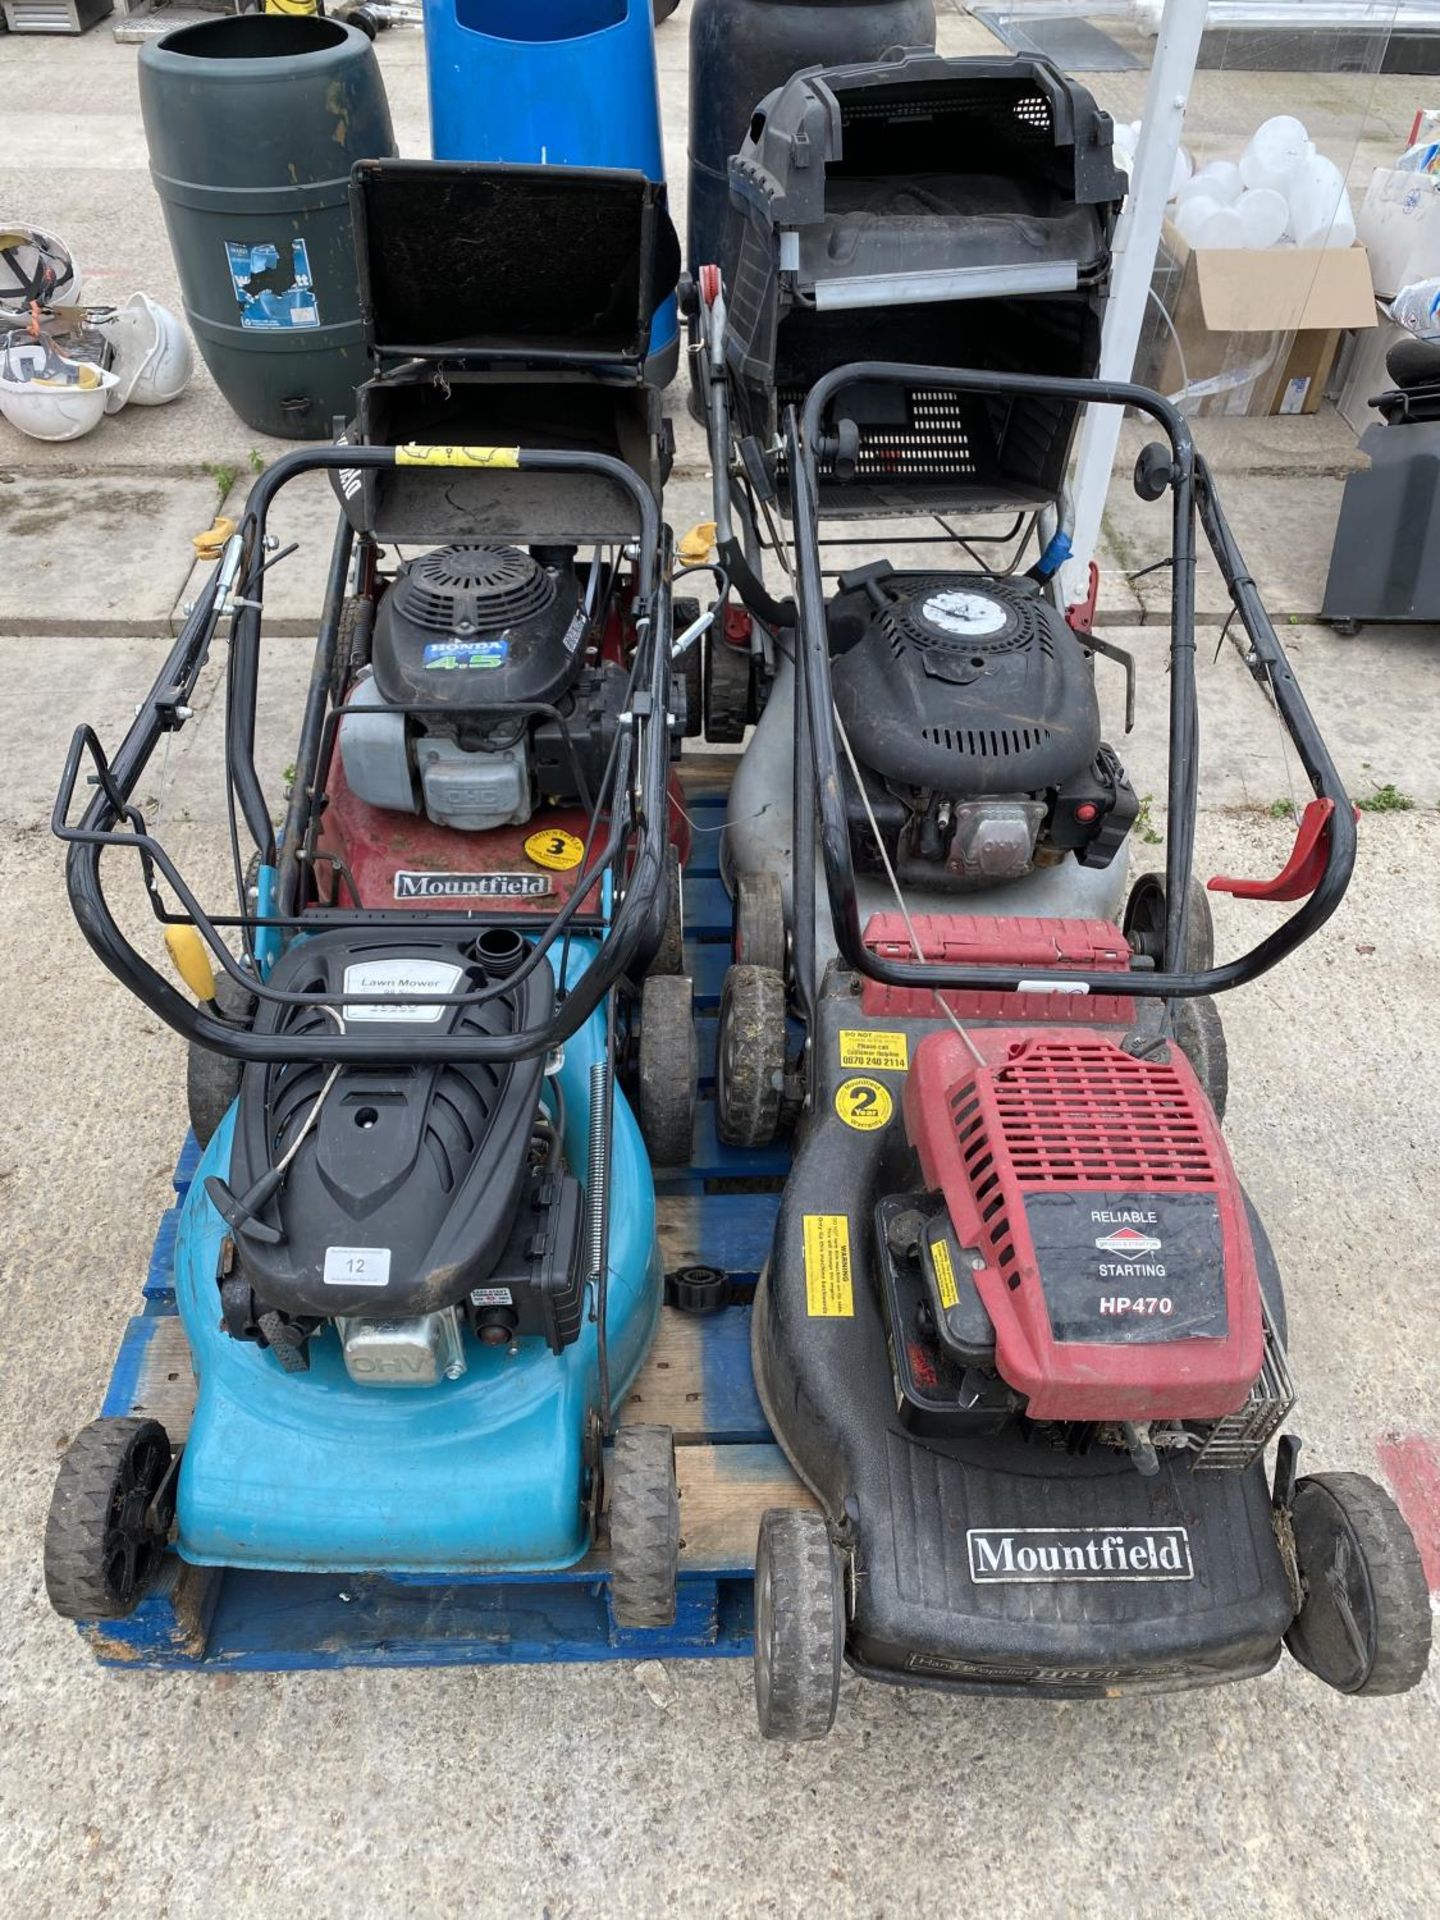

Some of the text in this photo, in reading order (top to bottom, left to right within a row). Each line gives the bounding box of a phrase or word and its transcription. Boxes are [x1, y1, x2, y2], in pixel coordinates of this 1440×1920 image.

[430, 642, 503, 651] HONDA
[424, 654, 503, 669] 4.5
[546, 837, 566, 855] 3
[401, 876, 546, 896] Mountfield
[361, 978, 441, 988] Lawn Mower
[843, 1055, 905, 1068] 0870 240 2114
[850, 1086, 878, 1117] 2
[854, 1108, 878, 1117] Year
[1091, 1211, 1158, 1224] RELIABLE
[346, 1258, 365, 1273] 12
[841, 1245, 849, 1282] WARNING
[1099, 1263, 1166, 1277] STARTING
[1100, 1297, 1173, 1315] HP470
[351, 1357, 426, 1373] OHV
[974, 1535, 1184, 1572] Mountfield
